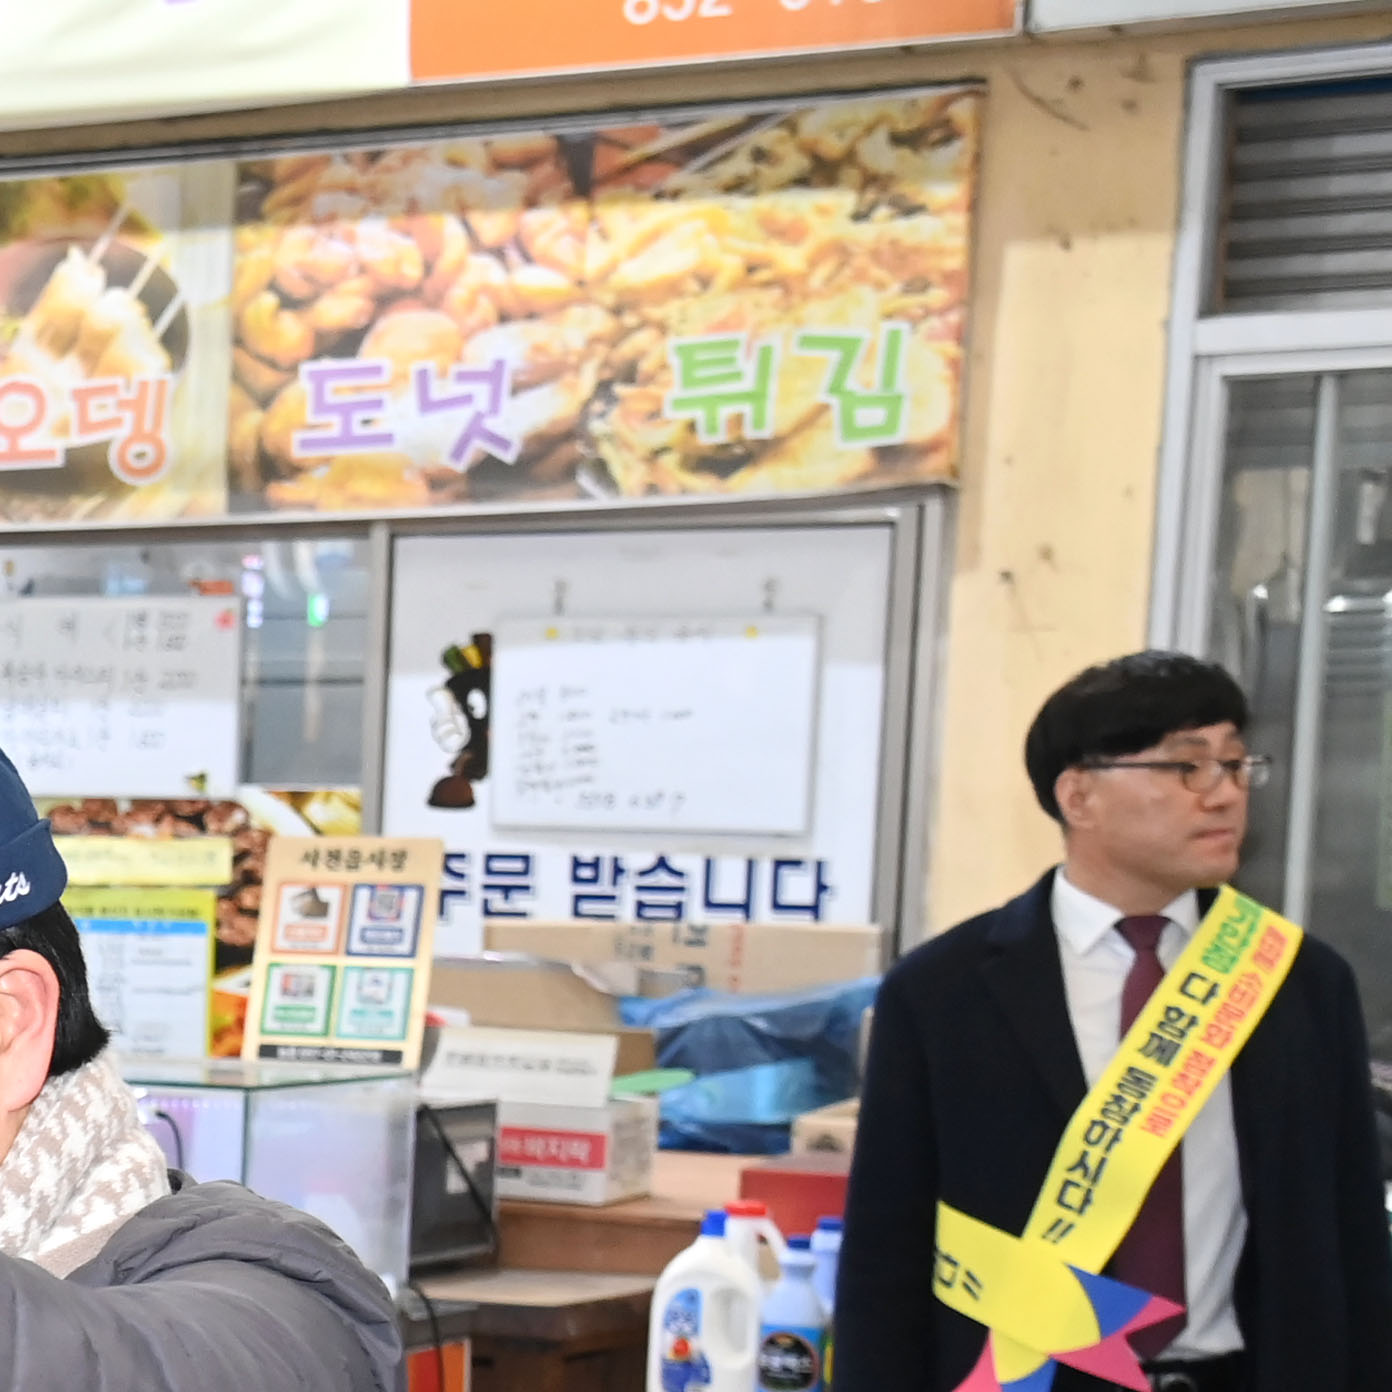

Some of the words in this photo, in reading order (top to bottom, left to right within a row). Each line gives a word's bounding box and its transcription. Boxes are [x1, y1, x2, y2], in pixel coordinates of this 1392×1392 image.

[292, 354, 518, 470] 도넛
[666, 326, 909, 446] 튀김
[570, 852, 831, 922] 받습니다
